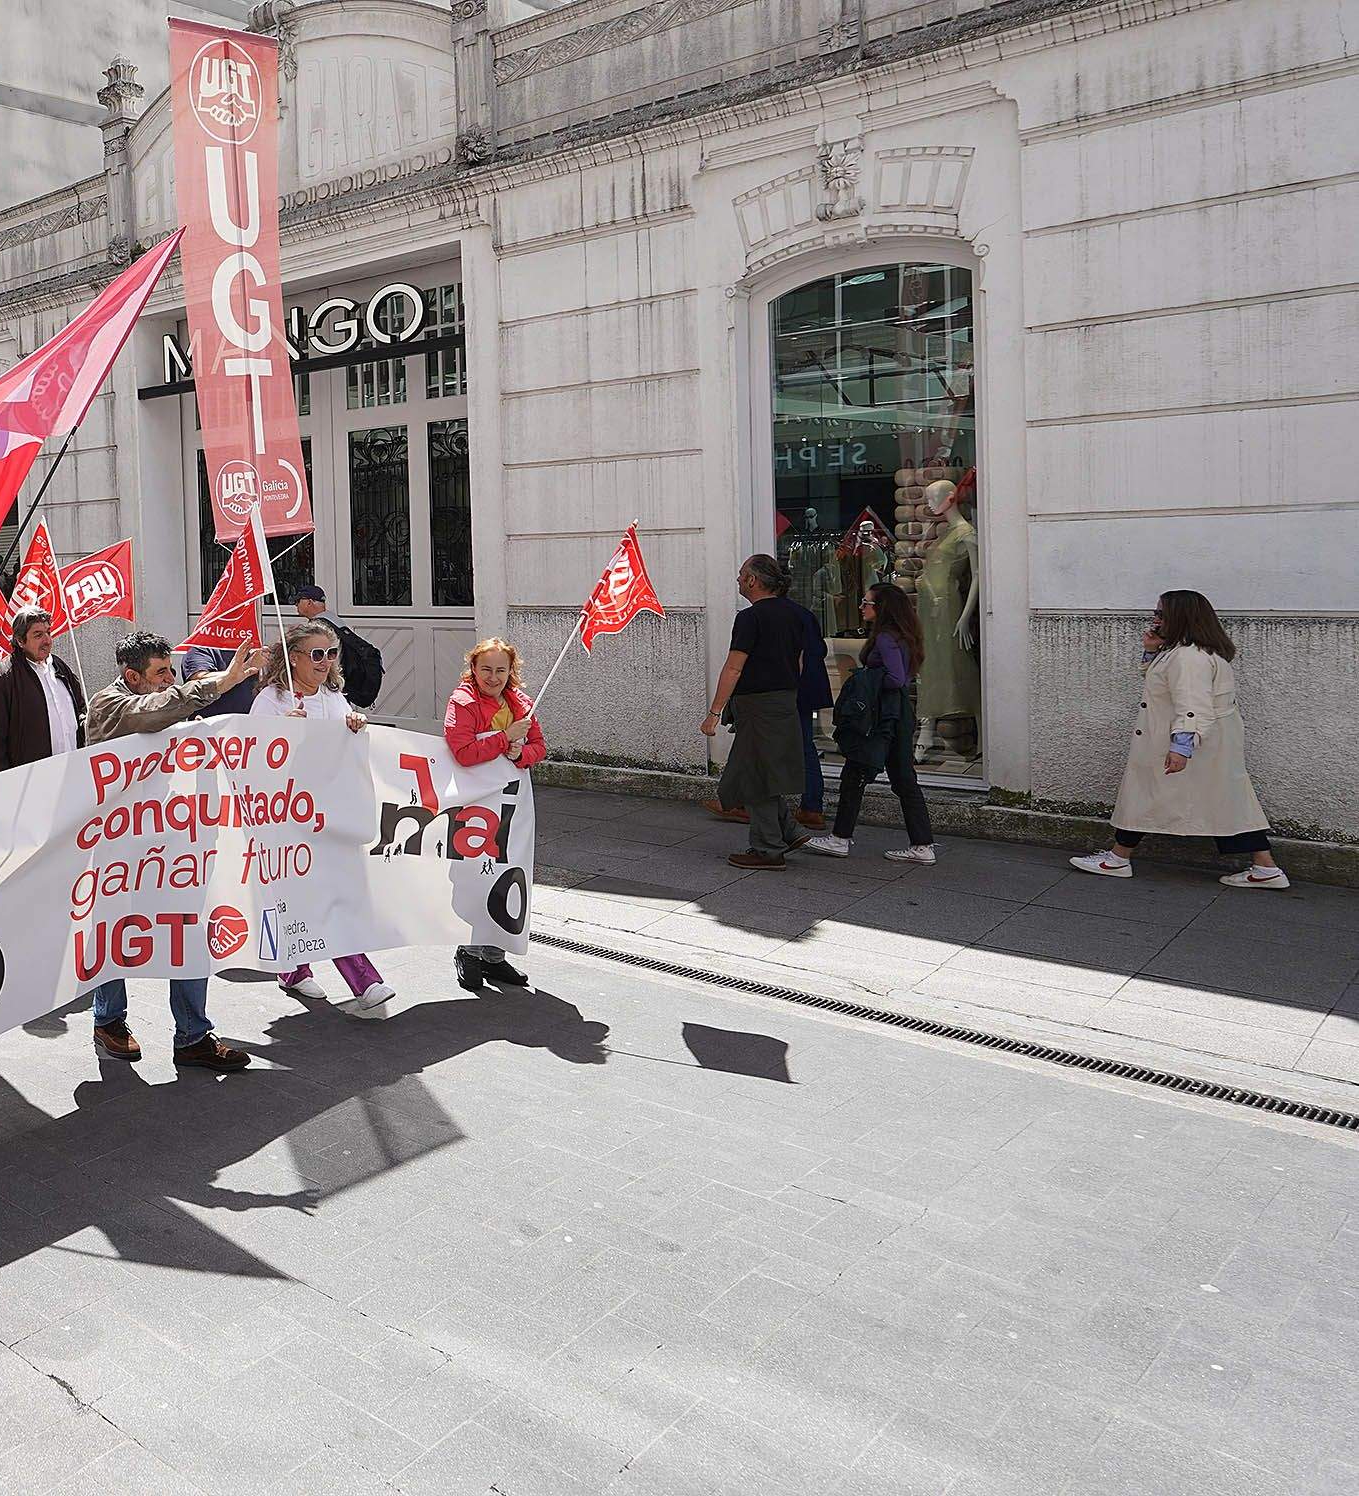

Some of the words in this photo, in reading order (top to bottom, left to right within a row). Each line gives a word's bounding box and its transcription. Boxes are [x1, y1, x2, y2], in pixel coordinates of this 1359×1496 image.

[199, 56, 254, 100] UGT
[205, 147, 273, 455] UGT
[222, 471, 257, 496] UGT
[262, 479, 290, 492] Galicia
[263, 493, 290, 502] PONTEVEDRA
[89, 735, 257, 804] Protexer
[265, 736, 290, 769] o
[70, 845, 218, 921] gañar
[74, 912, 201, 982] UGT
[297, 937, 327, 953] Deza
